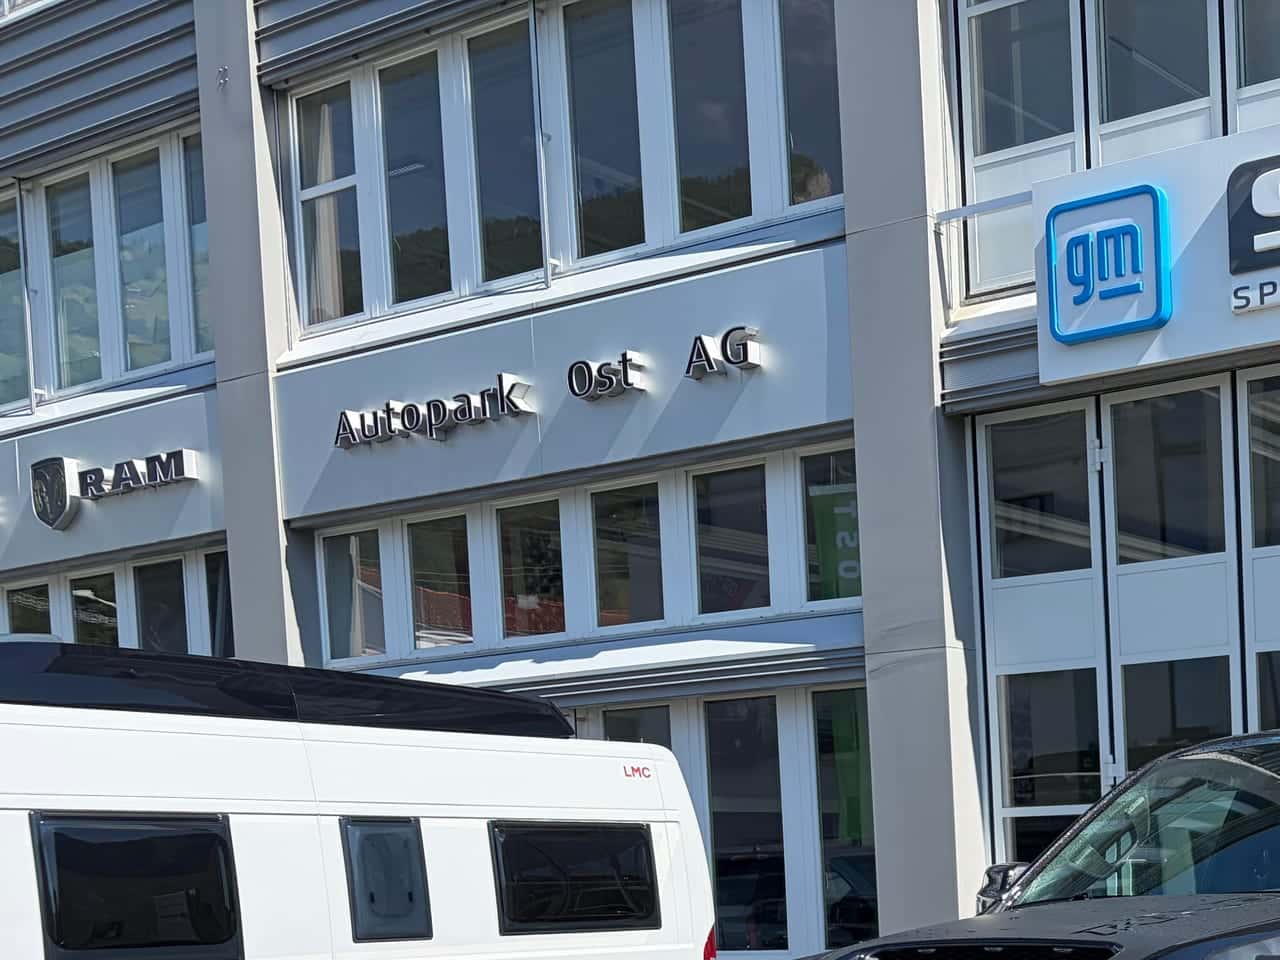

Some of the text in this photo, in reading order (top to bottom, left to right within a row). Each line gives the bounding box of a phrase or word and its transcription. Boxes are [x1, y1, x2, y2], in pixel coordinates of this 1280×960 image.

[1066, 223, 1142, 306] gm
[334, 326, 753, 447] Autopark Ost AG
[78, 449, 189, 498] RAM
[623, 765, 651, 778] LMC
